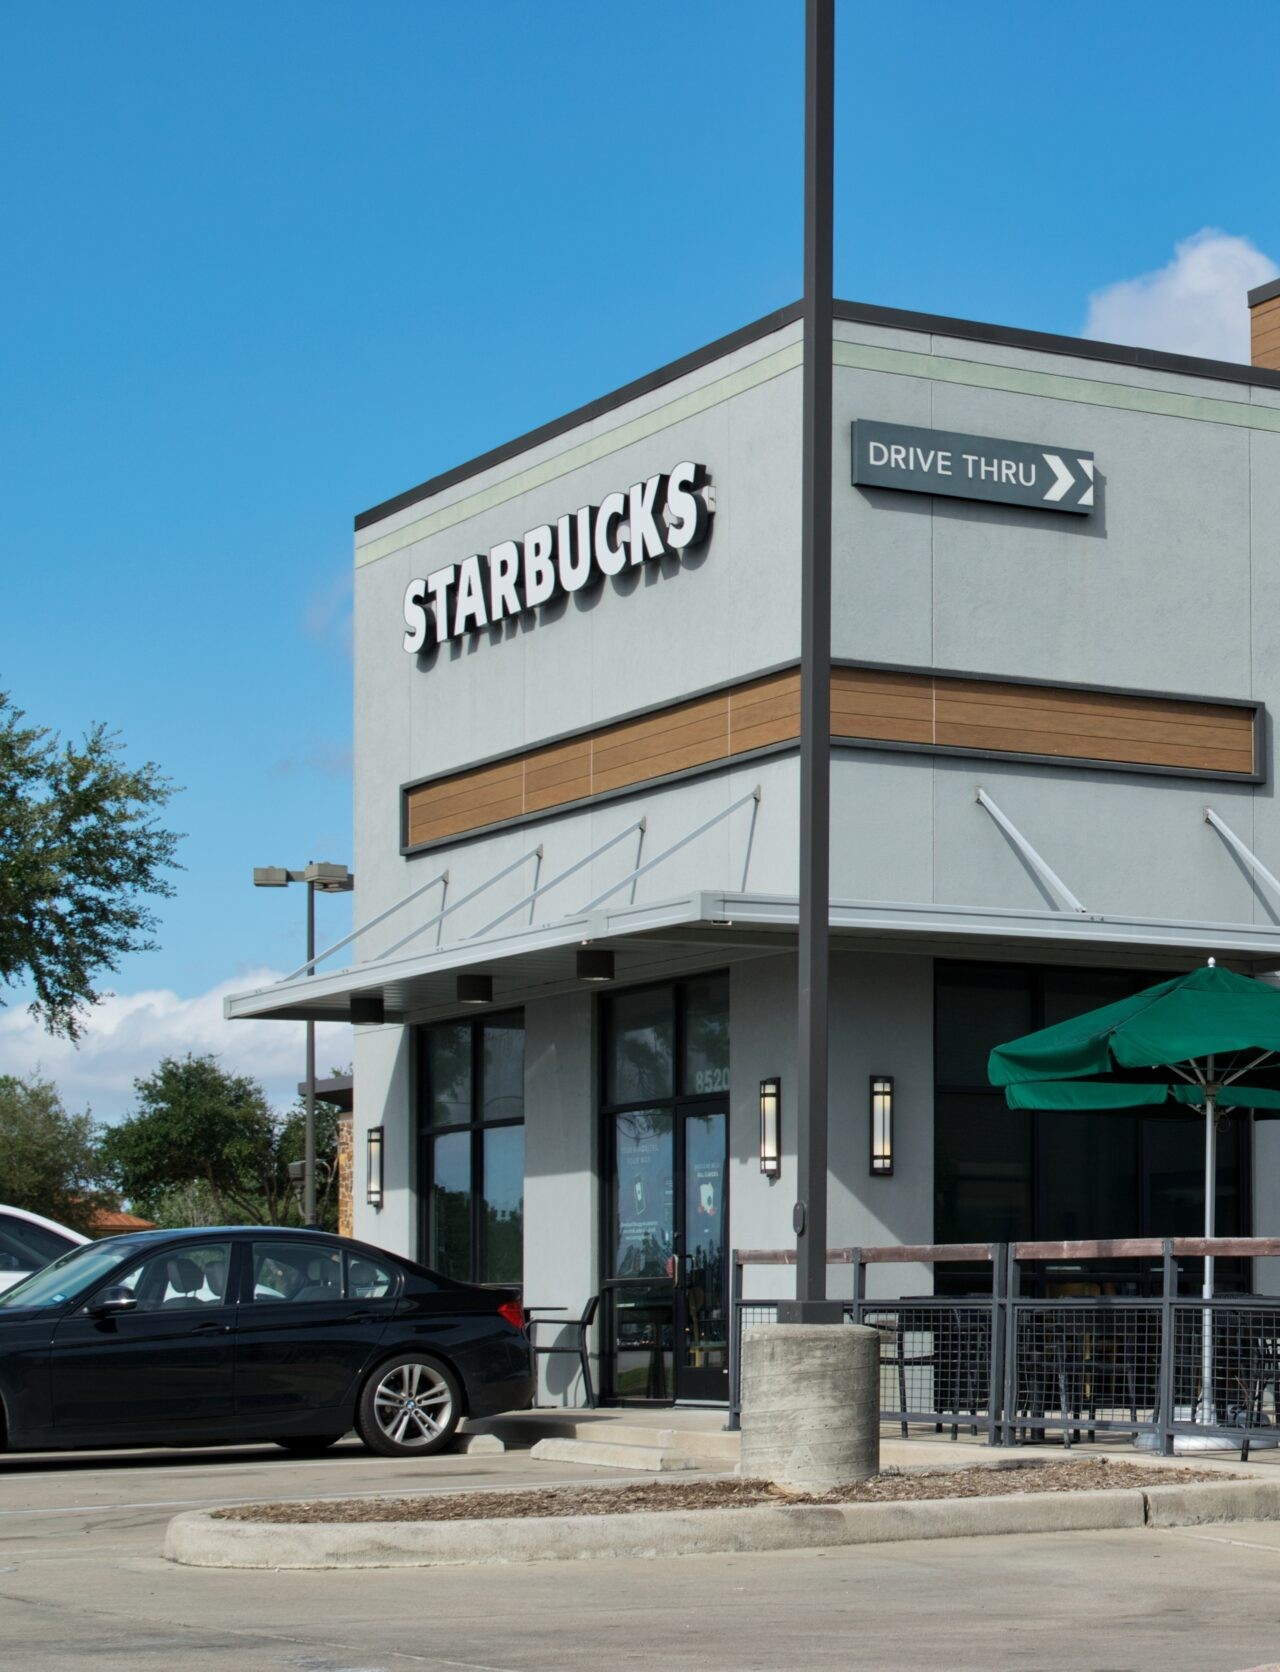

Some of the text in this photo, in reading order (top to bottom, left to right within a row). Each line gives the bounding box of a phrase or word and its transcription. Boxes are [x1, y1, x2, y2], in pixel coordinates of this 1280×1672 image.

[869, 441, 1036, 487] DRIVE THRU
[403, 461, 700, 654] STARBUCKS
[696, 1067, 730, 1095] 8520
